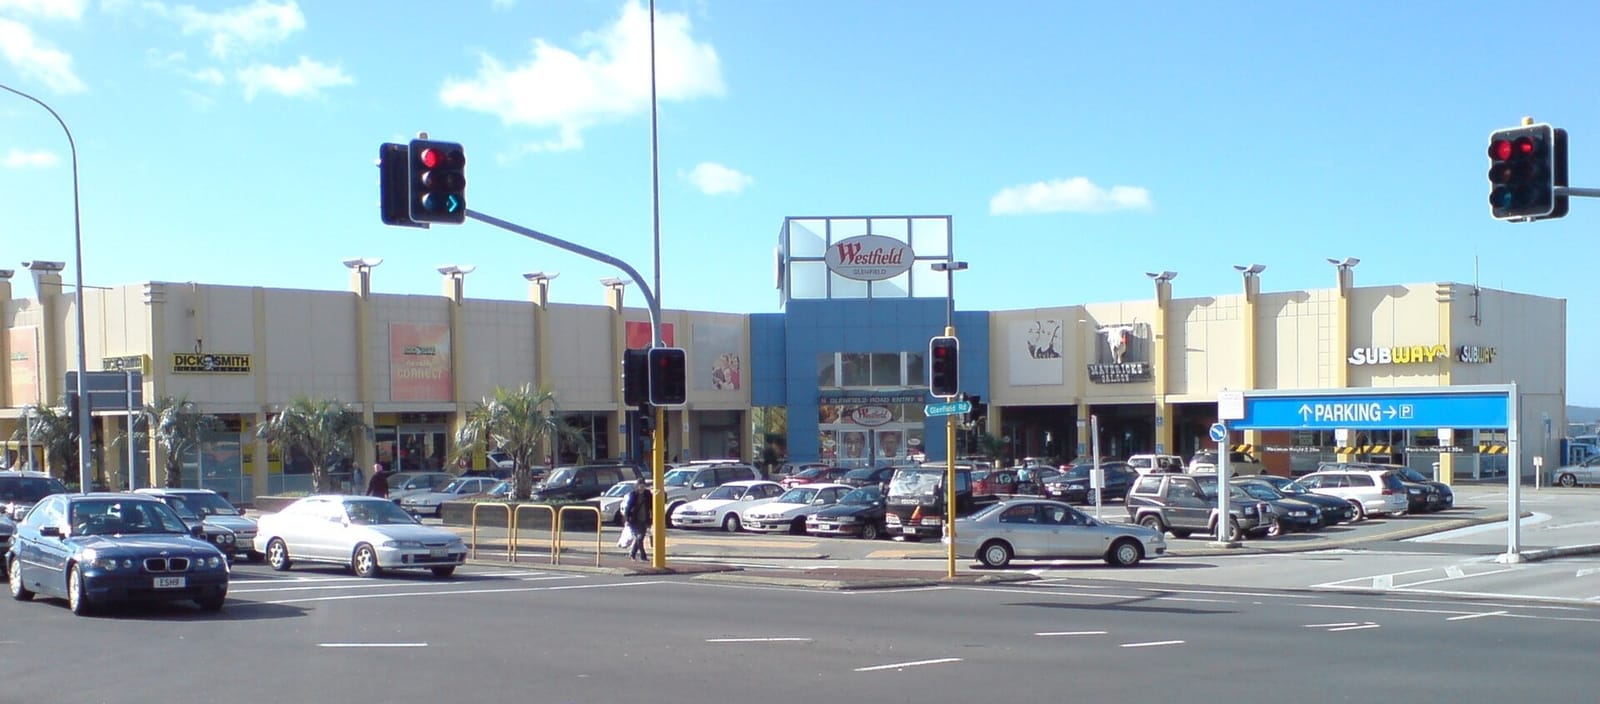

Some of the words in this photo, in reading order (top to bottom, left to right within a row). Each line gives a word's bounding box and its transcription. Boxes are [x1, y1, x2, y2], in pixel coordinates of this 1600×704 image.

[837, 242, 904, 265] Westfield
[175, 355, 205, 366] DICK
[214, 355, 249, 366] SMITH
[1348, 344, 1448, 365] SUBWAY
[1460, 345, 1497, 363] SUBWAY
[1090, 364, 1143, 375] MAVERICKS
[930, 404, 956, 414] Glenfield
[958, 402, 968, 411] Rd
[1315, 403, 1382, 422] PARKING
